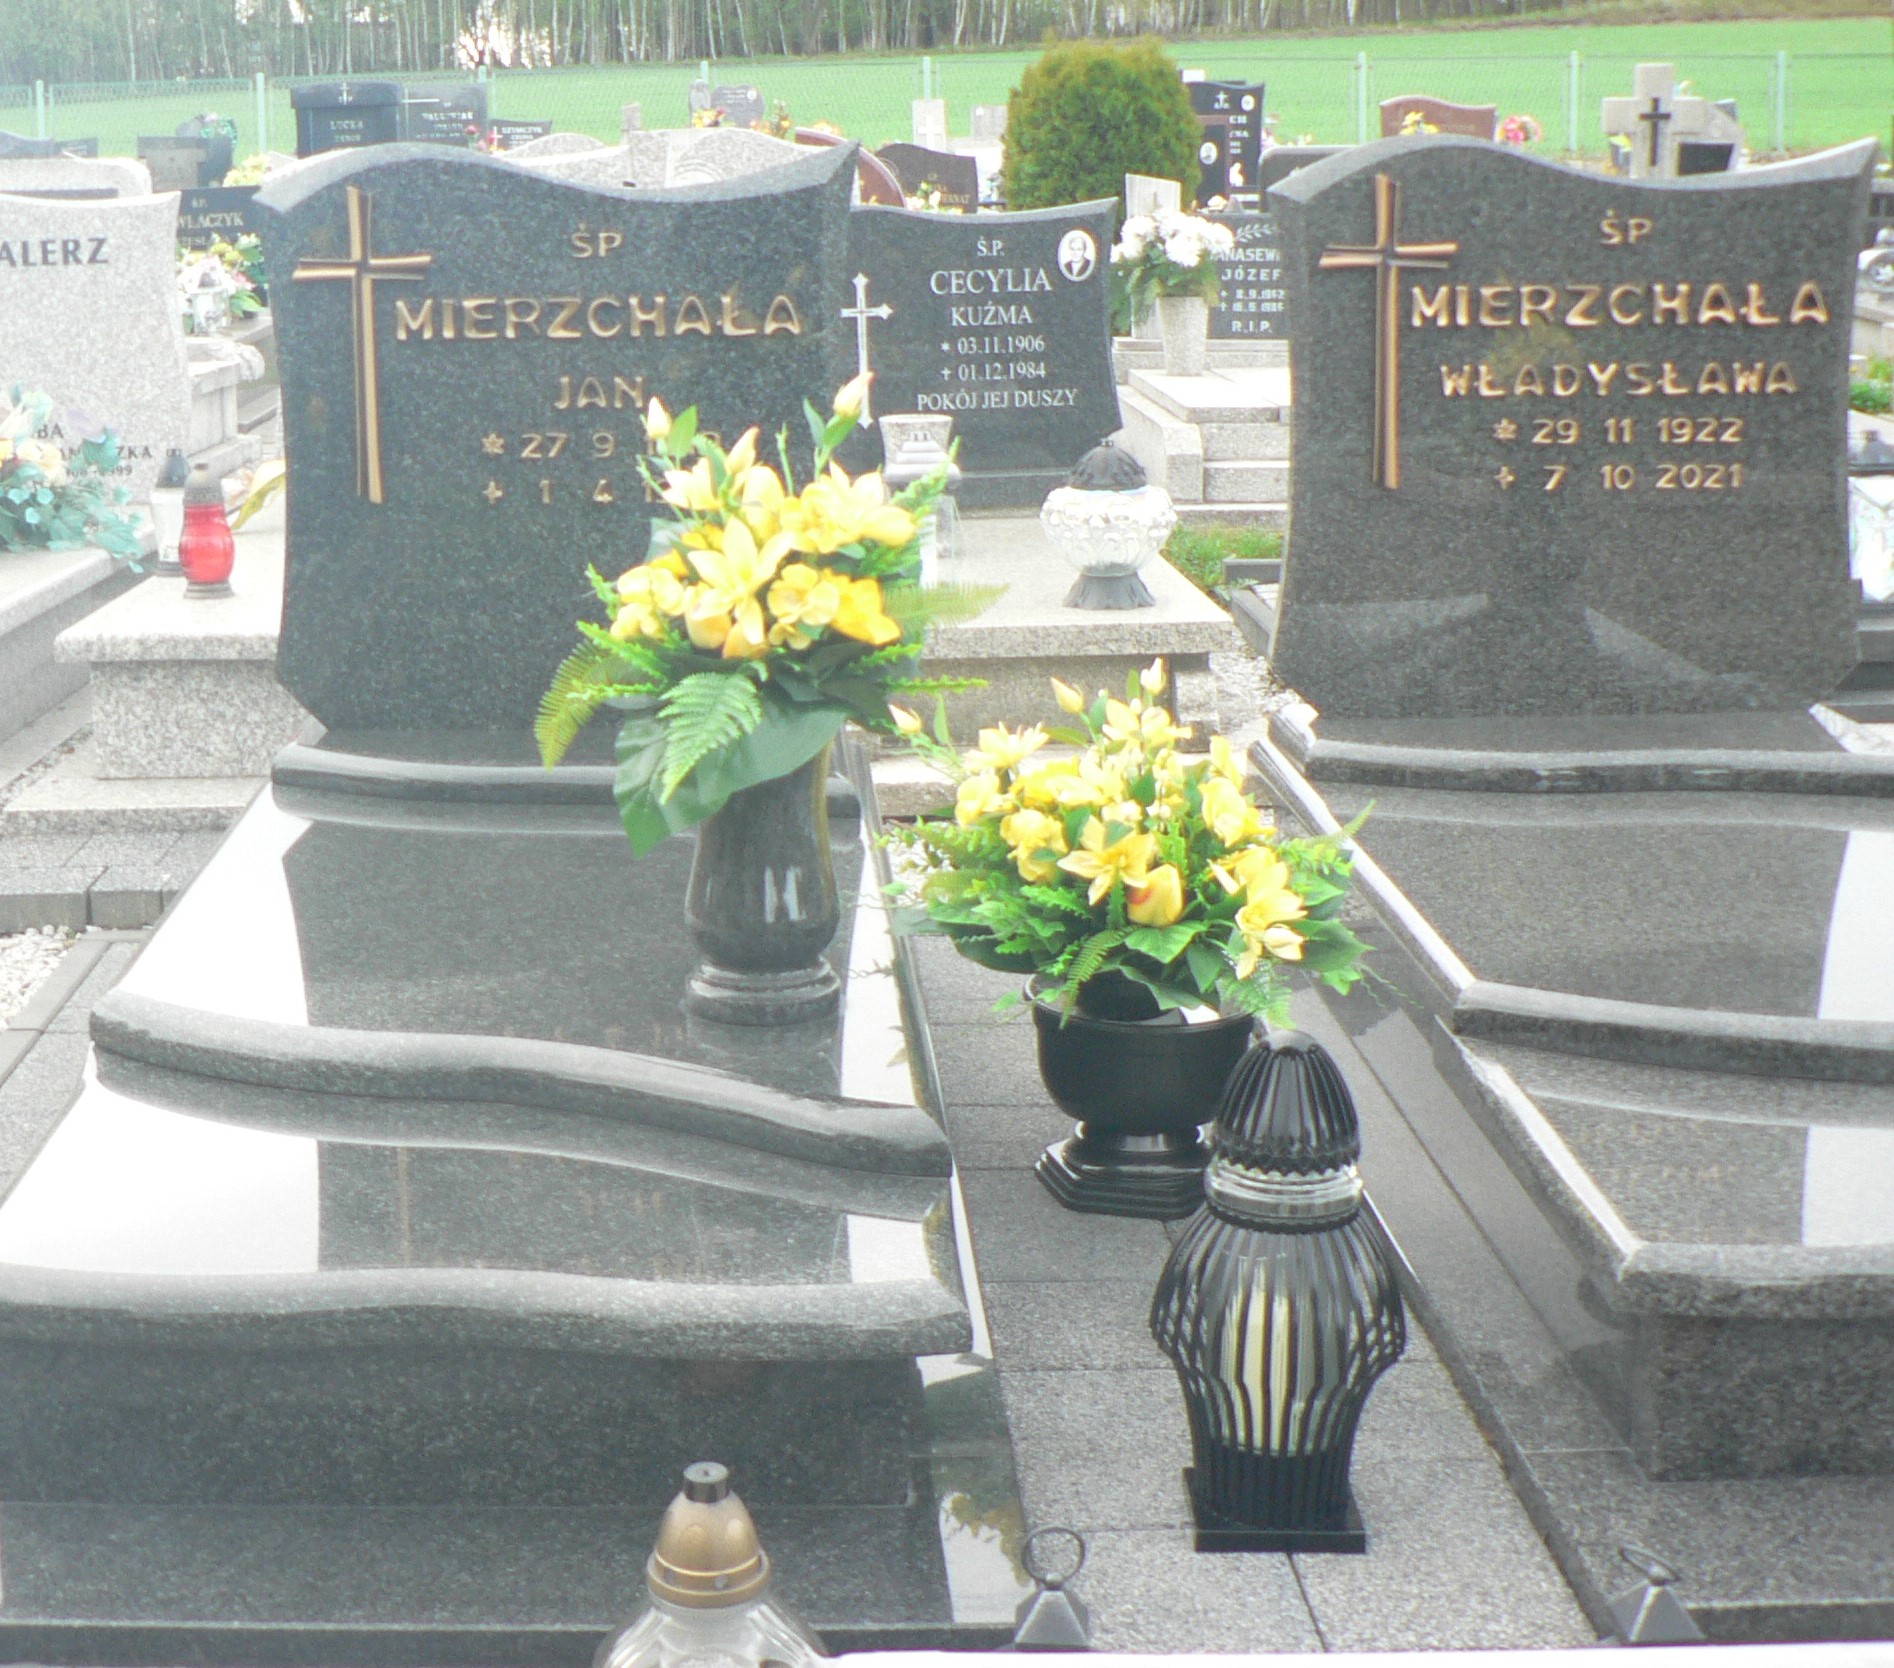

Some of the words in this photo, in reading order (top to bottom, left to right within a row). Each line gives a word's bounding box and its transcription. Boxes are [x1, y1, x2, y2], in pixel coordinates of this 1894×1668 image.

[930, 268, 1053, 295] CECYLIA
[1221, 265, 1282, 281] JÓZEF
[395, 296, 801, 340] MIERZCHAŁA
[951, 304, 1034, 327] KUŹMA
[1411, 282, 1829, 327] MIERZCHAŁA
[957, 337, 1046, 354] 03.11.1906
[958, 363, 1047, 381] 01.12.1984
[1439, 360, 1797, 398] WŁADYSŁAWA
[553, 374, 645, 410] JAN
[916, 391, 978, 412] POKÓJ
[980, 392, 1009, 410] JEJ
[1013, 388, 1079, 408] DUSZY
[1530, 419, 1581, 444] 29
[1604, 417, 1635, 443] 11
[1656, 416, 1745, 444] 1922
[521, 432, 568, 459] 27
[592, 431, 616, 458] 9
[1543, 464, 1568, 491] 7
[1600, 462, 1635, 489] 10
[1654, 462, 1744, 489] 2021
[539, 478, 553, 504] 1
[592, 478, 615, 504] 4
